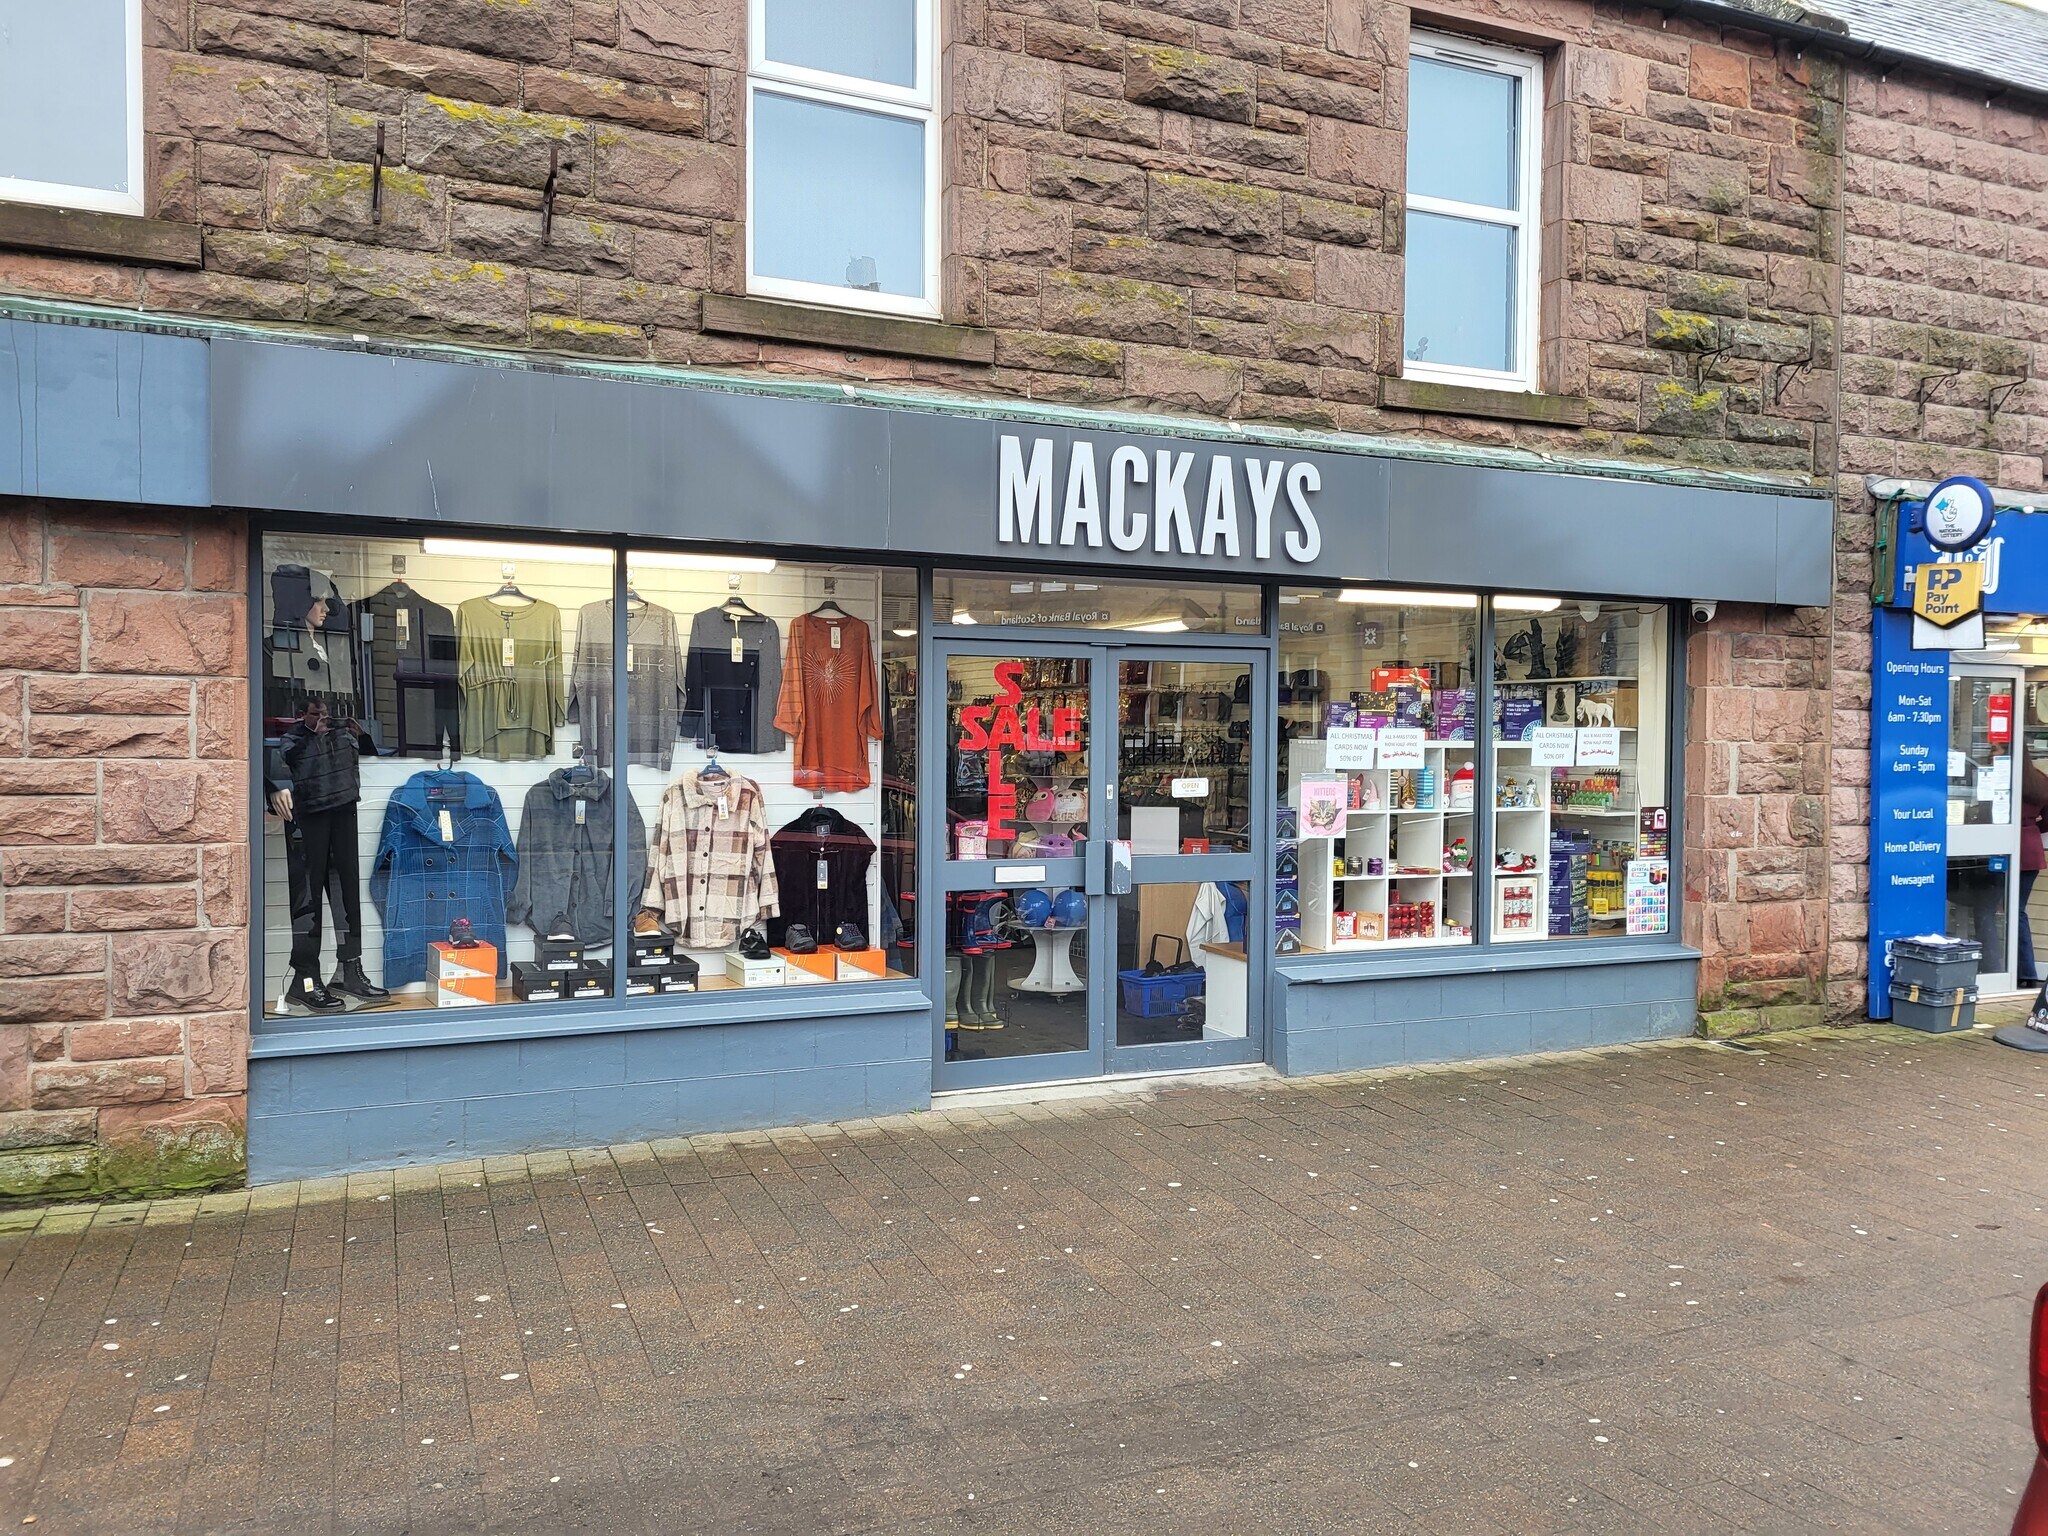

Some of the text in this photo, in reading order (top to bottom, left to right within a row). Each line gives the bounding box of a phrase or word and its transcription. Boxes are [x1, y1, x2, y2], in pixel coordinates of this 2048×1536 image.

[1000, 435, 1322, 562] MACKAYS
[1926, 592, 1948, 605] Pay
[1925, 603, 1959, 614] Point
[1886, 661, 1944, 676] Opening Hours
[1898, 695, 1932, 706] Mon-Sat
[1887, 711, 1905, 722] 6am
[1912, 711, 1941, 725] 7:30pm
[958, 706, 1081, 752] SALE
[1330, 732, 1373, 740] ALL CHRISTMAS
[987, 661, 1027, 840] SALE
[1900, 744, 1929, 758] Sunday
[1893, 761, 1910, 772] 6am
[1917, 761, 1935, 774] 5pm
[1893, 808, 1934, 820] Your Local
[1884, 841, 1941, 854] Home Delivery
[1891, 873, 1935, 887] Newsagent
